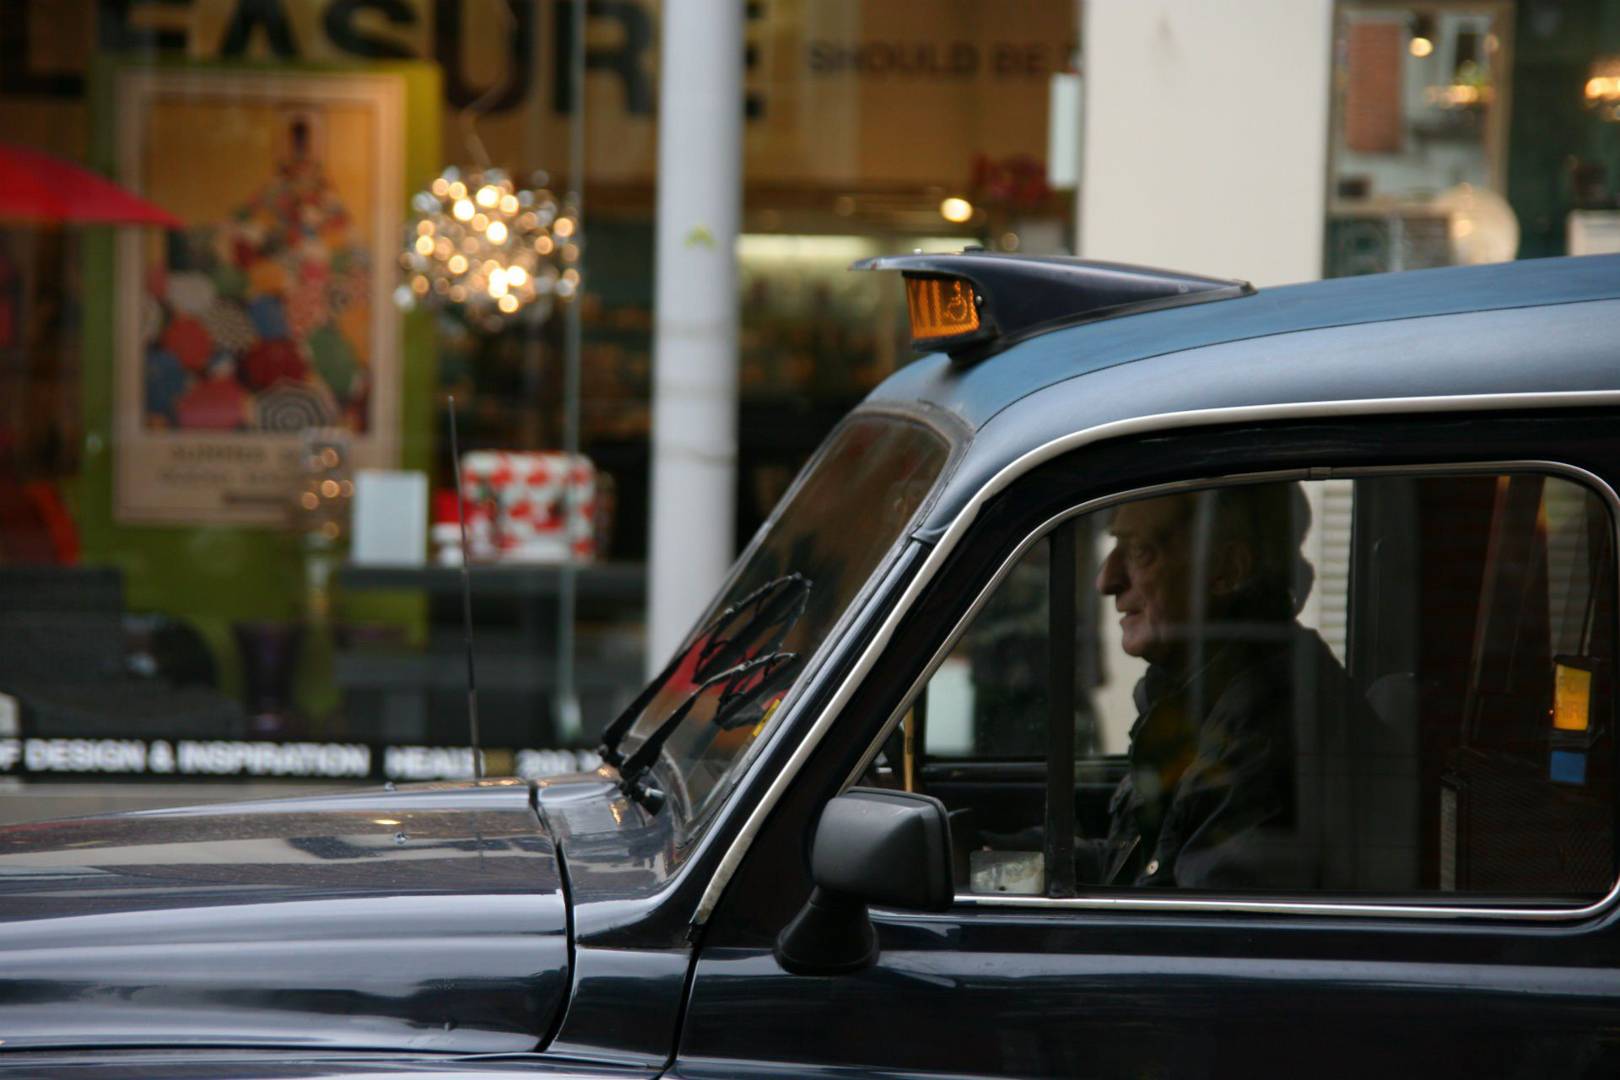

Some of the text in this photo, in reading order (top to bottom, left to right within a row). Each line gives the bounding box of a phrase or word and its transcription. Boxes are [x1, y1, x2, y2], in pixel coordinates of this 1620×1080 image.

[808, 40, 976, 75] SHOULD
[991, 40, 1049, 76] BE
[24, 738, 146, 771] DESIGN
[149, 739, 174, 773] &
[177, 739, 370, 776] INSPIRATION
